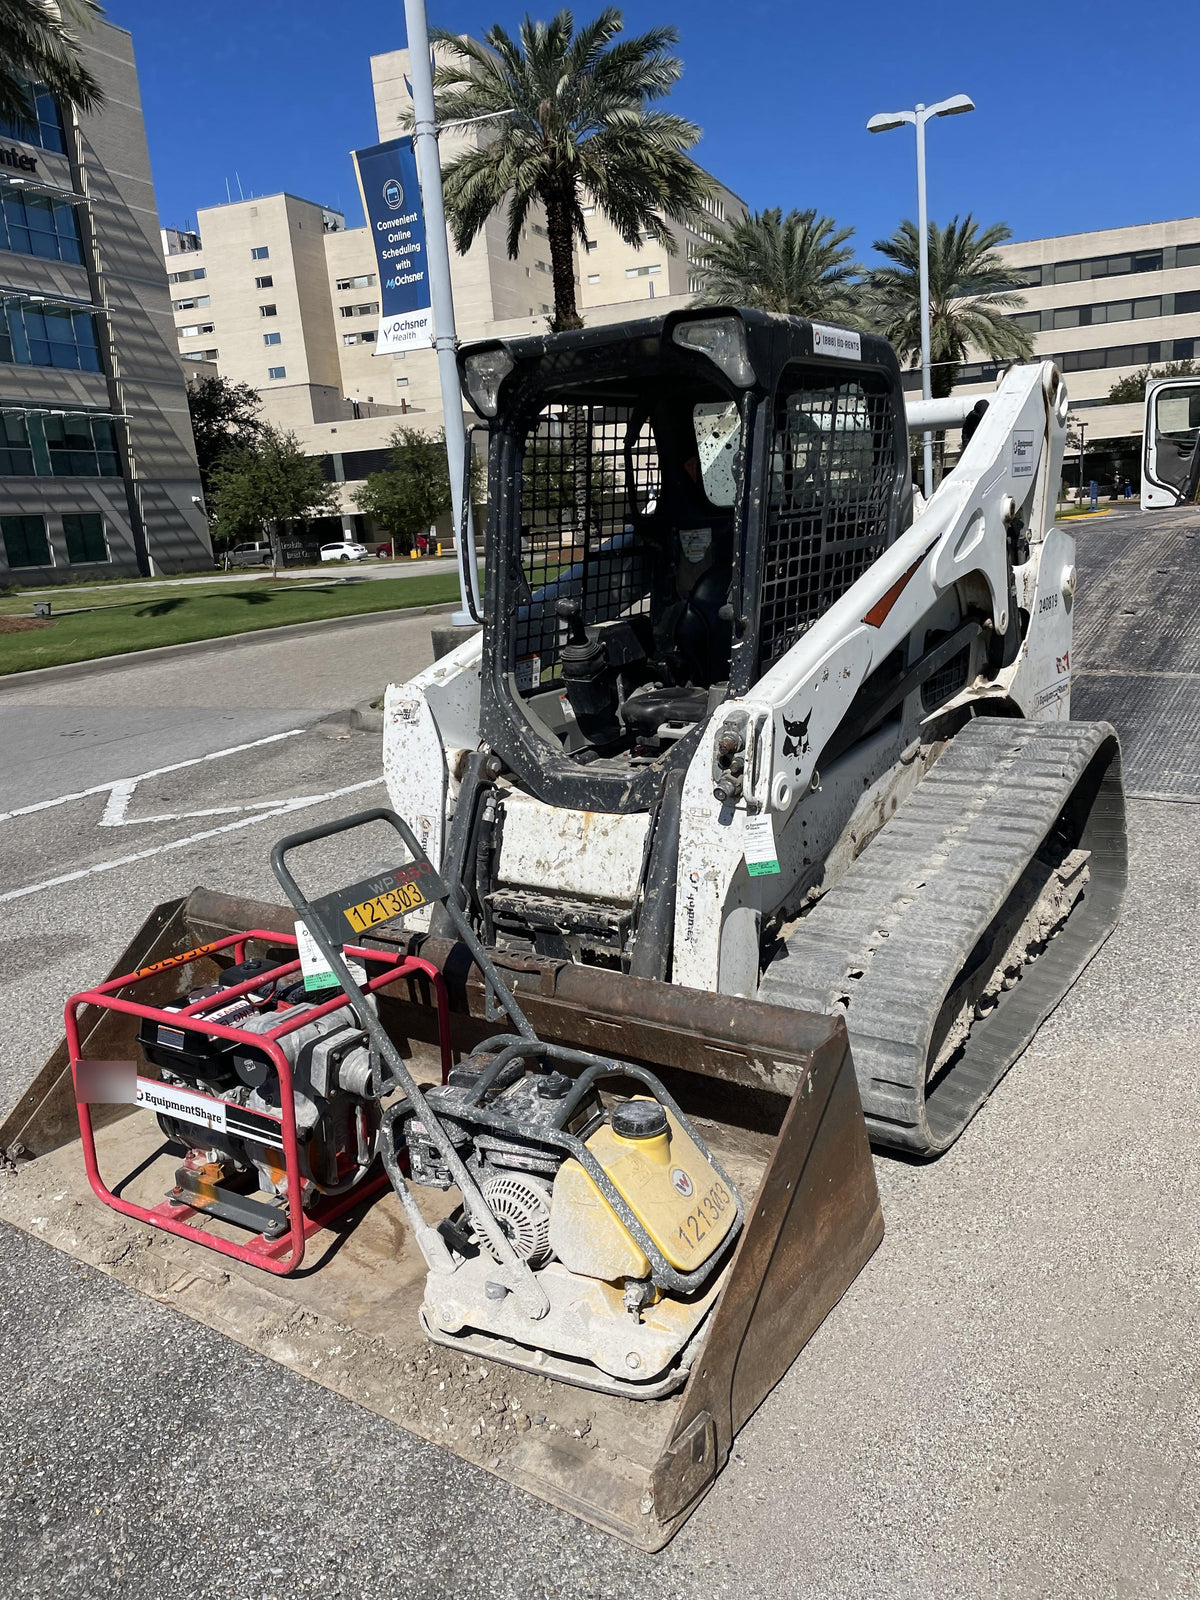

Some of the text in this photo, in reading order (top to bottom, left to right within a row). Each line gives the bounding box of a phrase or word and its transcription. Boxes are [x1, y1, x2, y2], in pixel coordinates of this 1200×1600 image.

[377, 212, 418, 231] Convenient
[388, 230, 411, 243] Online
[382, 242, 420, 260] Scheduling
[395, 259, 411, 271] with
[385, 271, 424, 290] MyOchsner
[393, 318, 428, 332] Ochsner
[392, 331, 417, 342] Health
[352, 884, 422, 927] 121303
[145, 1091, 222, 1124] EquipmentShare
[678, 1182, 730, 1249] 121303
